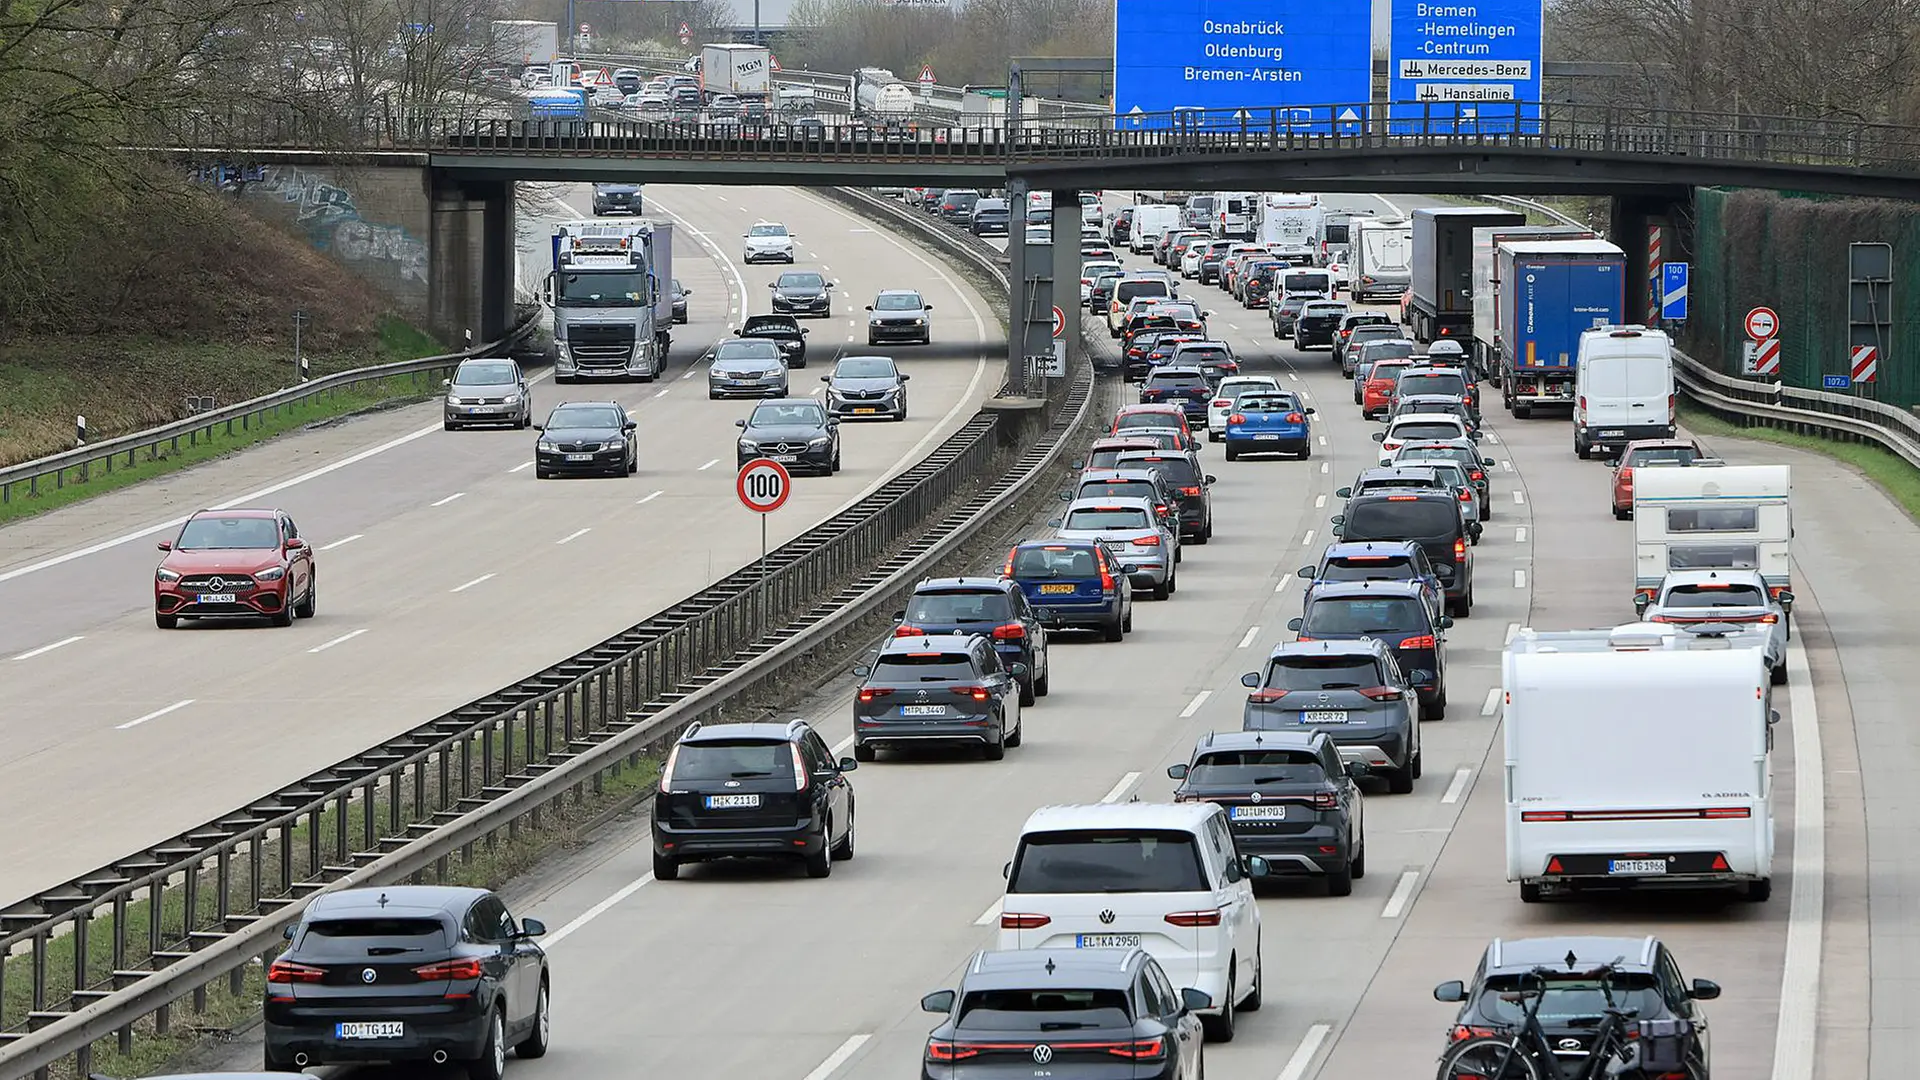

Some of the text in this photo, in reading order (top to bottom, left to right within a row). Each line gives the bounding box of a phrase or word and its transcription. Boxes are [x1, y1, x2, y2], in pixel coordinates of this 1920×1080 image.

[1417, 3, 1477, 17] Bremen
[1203, 20, 1284, 35] Osnabrück
[1417, 22, 1515, 39] -Hemelingen
[1205, 43, 1282, 61] Oldenburg
[1417, 40, 1489, 54] -Centrum
[736, 60, 763, 74] MGM
[1427, 64, 1527, 76] Mercedes-Benz
[1184, 67, 1302, 82] Bremen-Arsten
[1443, 88, 1511, 100] Hansalinie
[1669, 265, 1683, 275] 100
[747, 474, 780, 498] 100
[733, 796, 758, 805] 2118
[1236, 808, 1249, 817] DU
[1267, 807, 1284, 816] 903
[1083, 935, 1139, 947] EL KA 2950
[343, 1023, 401, 1035] DO TG 114
